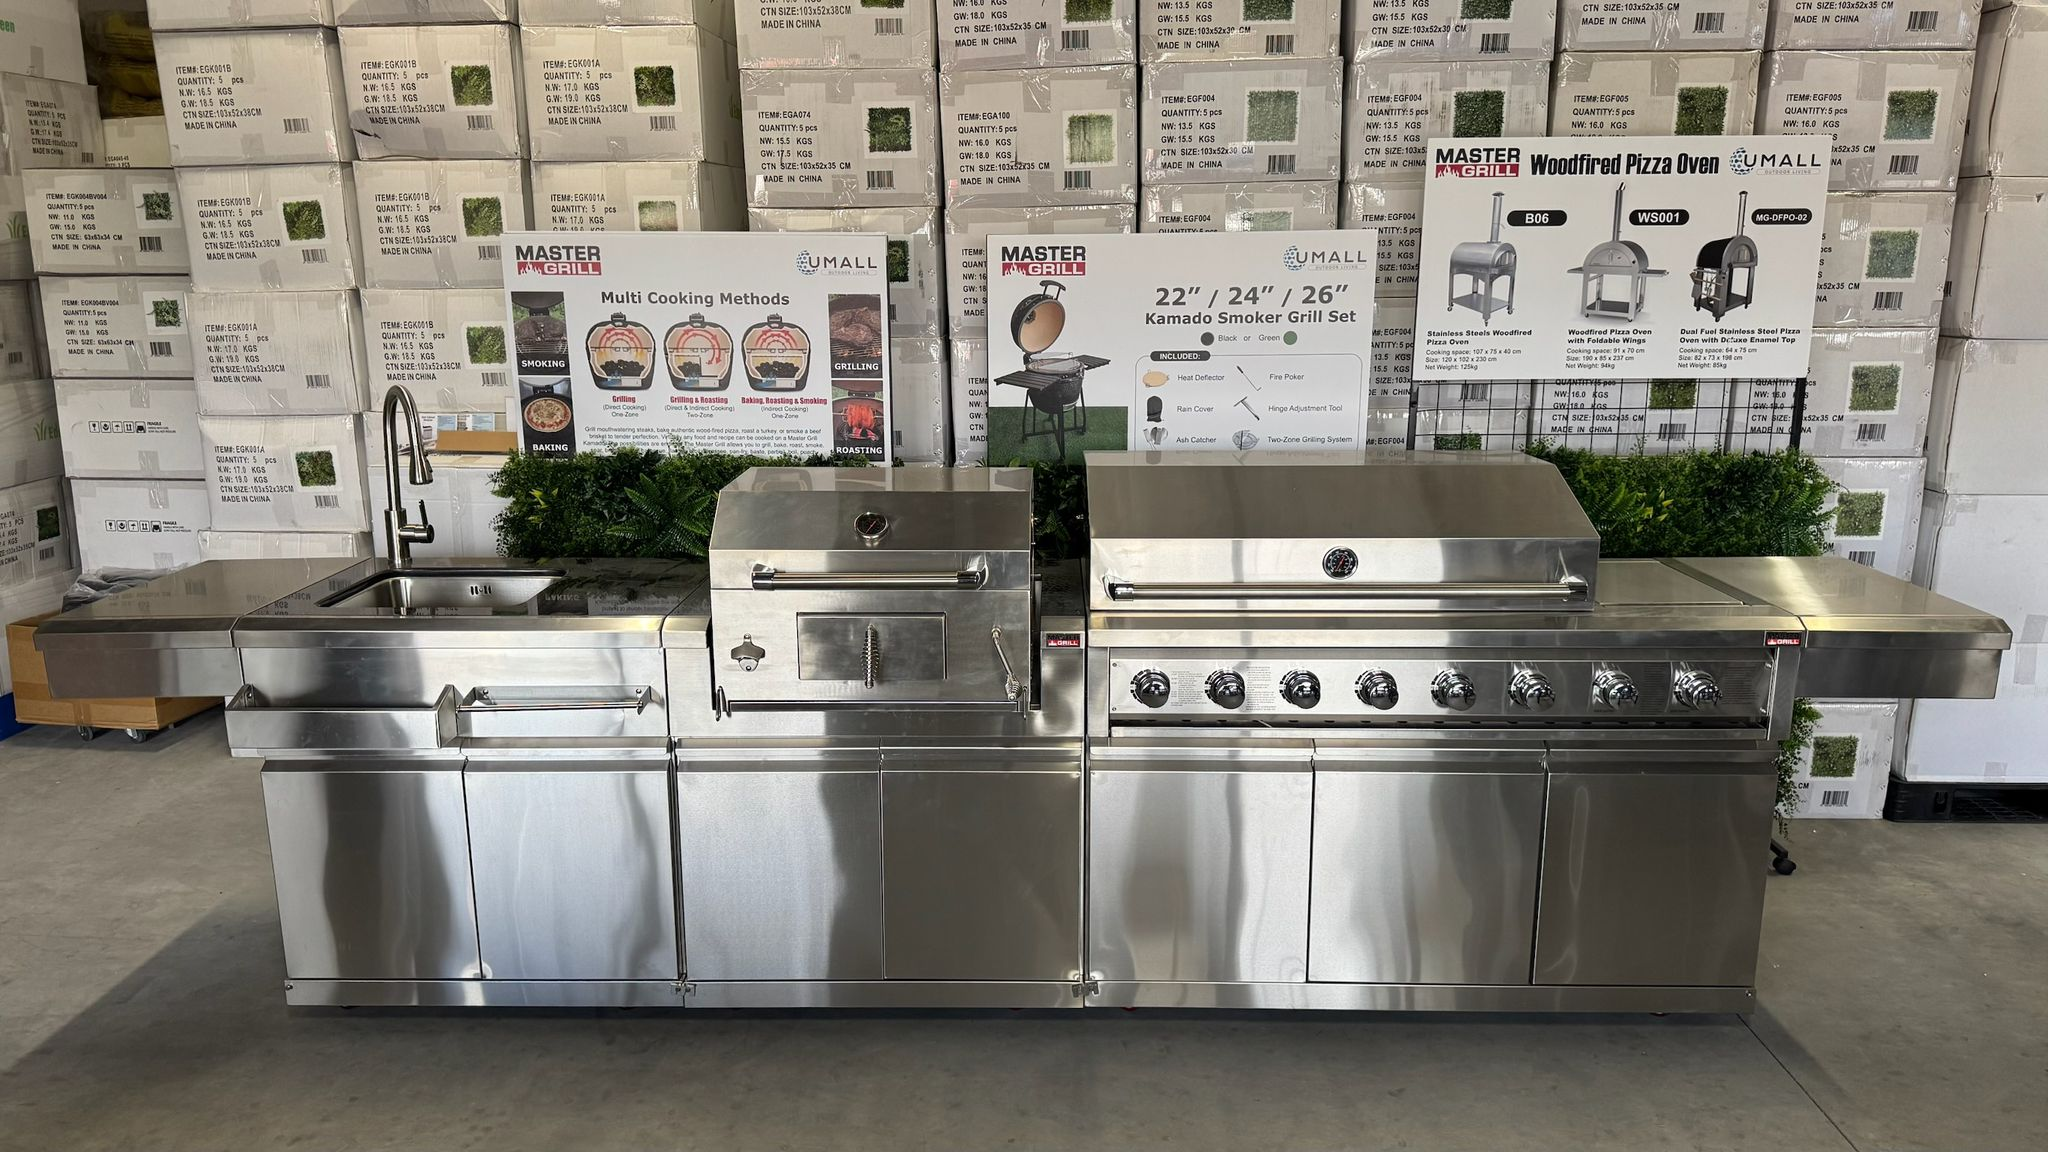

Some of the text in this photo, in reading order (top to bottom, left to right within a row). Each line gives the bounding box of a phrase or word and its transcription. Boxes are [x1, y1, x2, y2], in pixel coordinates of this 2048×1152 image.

[1581, 17, 1605, 26] MADE
[1621, 16, 1647, 25] CHINA
[1793, 15, 1818, 24] MADE
[1834, 15, 1860, 23] CHINA
[199, 64, 232, 74] EGK001B
[177, 76, 215, 86] QUANTITY:
[231, 77, 244, 86] pcs
[543, 71, 583, 81] QUANTITY:
[599, 72, 613, 81] pcs
[178, 86, 233, 97] N.W: 16.5 KGS
[184, 121, 206, 131] MADE
[215, 120, 238, 130] CHINA
[548, 116, 569, 126] MADE
[578, 116, 602, 125] CHINA
[1161, 122, 1216, 131] NW: 13.5 KGS
[759, 137, 813, 145] NW: 15.5 KGS
[958, 138, 1012, 147] NW: 16.0 KGS
[1436, 148, 1520, 163] MASTER
[1743, 153, 1821, 167] UMALL
[1160, 161, 1183, 170] MADE
[1198, 160, 1223, 169] CHINA
[1531, 153, 1720, 176] Woodfired Pizza Oven
[1461, 165, 1517, 177] GRILL
[960, 177, 982, 186] MADE
[997, 176, 1021, 184] CHINA
[1525, 213, 1549, 224] B06
[1638, 212, 1680, 223] WS001
[1755, 214, 1808, 223] MG-DFPO-02
[516, 246, 600, 261] MASTER
[1002, 246, 1086, 262] MASTER
[1294, 249, 1367, 264] UMALL
[807, 256, 877, 269] UMALL
[544, 263, 600, 275] GRILL
[1028, 263, 1084, 275] GRILL
[601, 291, 790, 308] Multi Cooking Methods
[1146, 310, 1357, 325] Kamado Smoker Grill Set
[1258, 334, 1281, 342] Green
[1781, 336, 1796, 345] Top
[1159, 353, 1202, 362] INCLUDED:
[521, 360, 566, 368] SMOKING
[834, 362, 879, 371] GRILLING
[612, 395, 636, 404] Grilling
[670, 396, 694, 405] Grilling
[700, 396, 729, 405] Roasting
[765, 396, 794, 406] Roasting
[799, 397, 828, 406] Smoking
[710, 405, 735, 413] Cooking)
[1268, 405, 1288, 414] Hinge
[1288, 405, 1327, 413] Adjustment
[1302, 436, 1326, 445] Grilling
[1327, 435, 1353, 444] System
[833, 444, 883, 454] ROASTING
[217, 465, 266, 474] N.W: 17.0 KGS
[221, 495, 240, 504] MADE
[248, 495, 271, 503] CHINA
